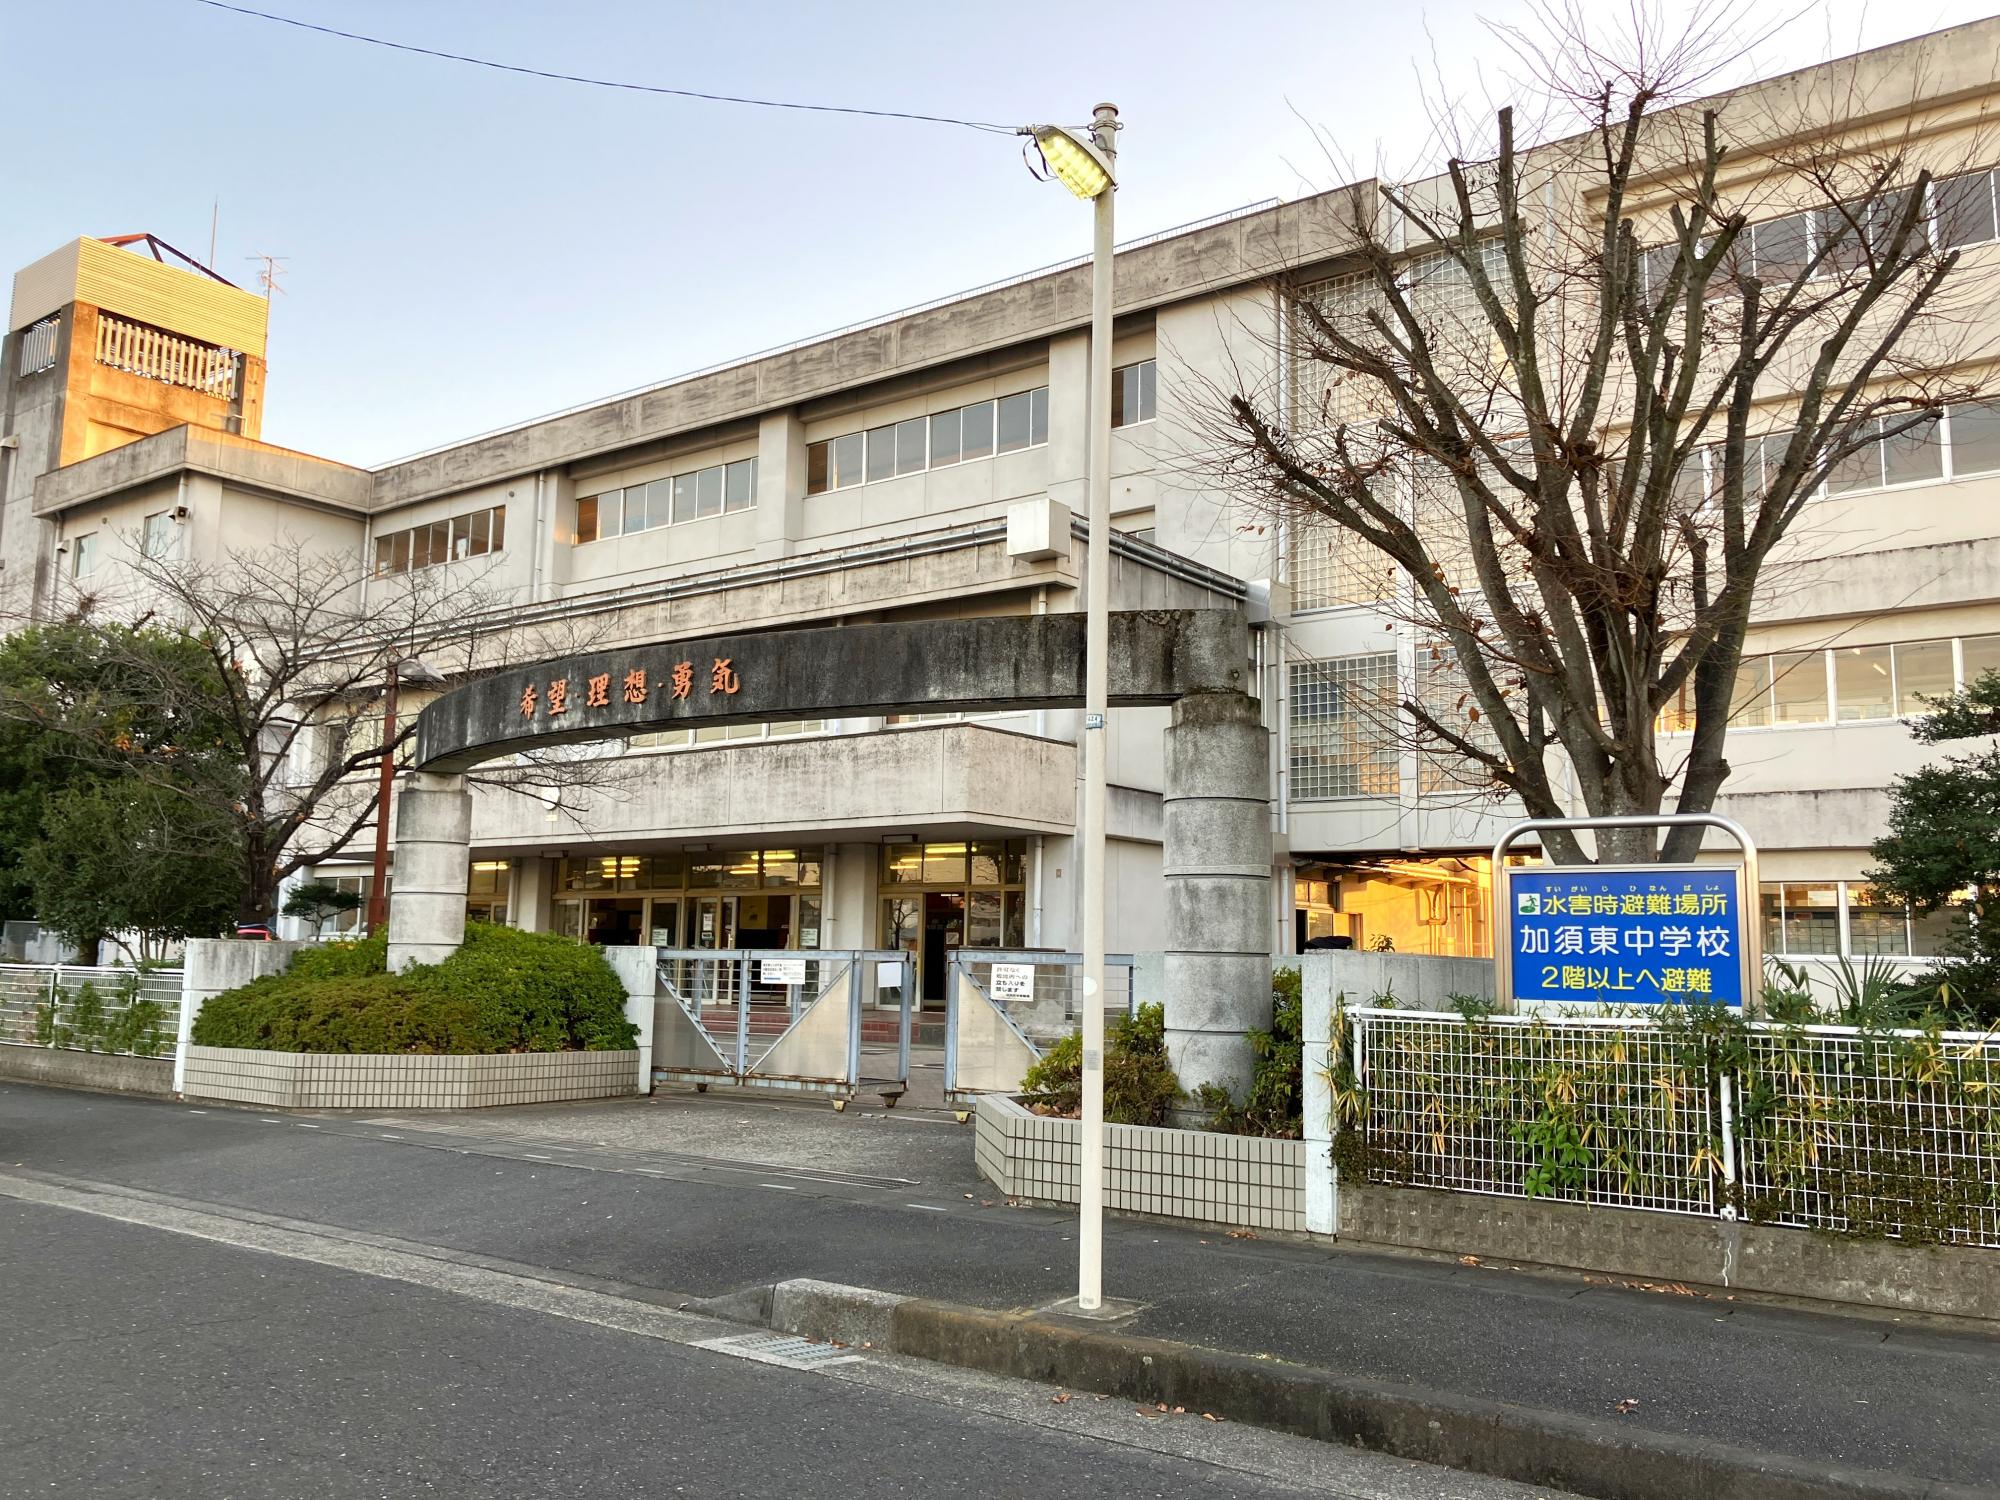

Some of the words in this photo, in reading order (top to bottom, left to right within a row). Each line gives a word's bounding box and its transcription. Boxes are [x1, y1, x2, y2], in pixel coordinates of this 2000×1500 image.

[1543, 893, 1728, 916] 水害時避難場所
[1520, 925, 1730, 957] 加須東中学校
[1541, 965, 1713, 993] 2階以上へ避難
